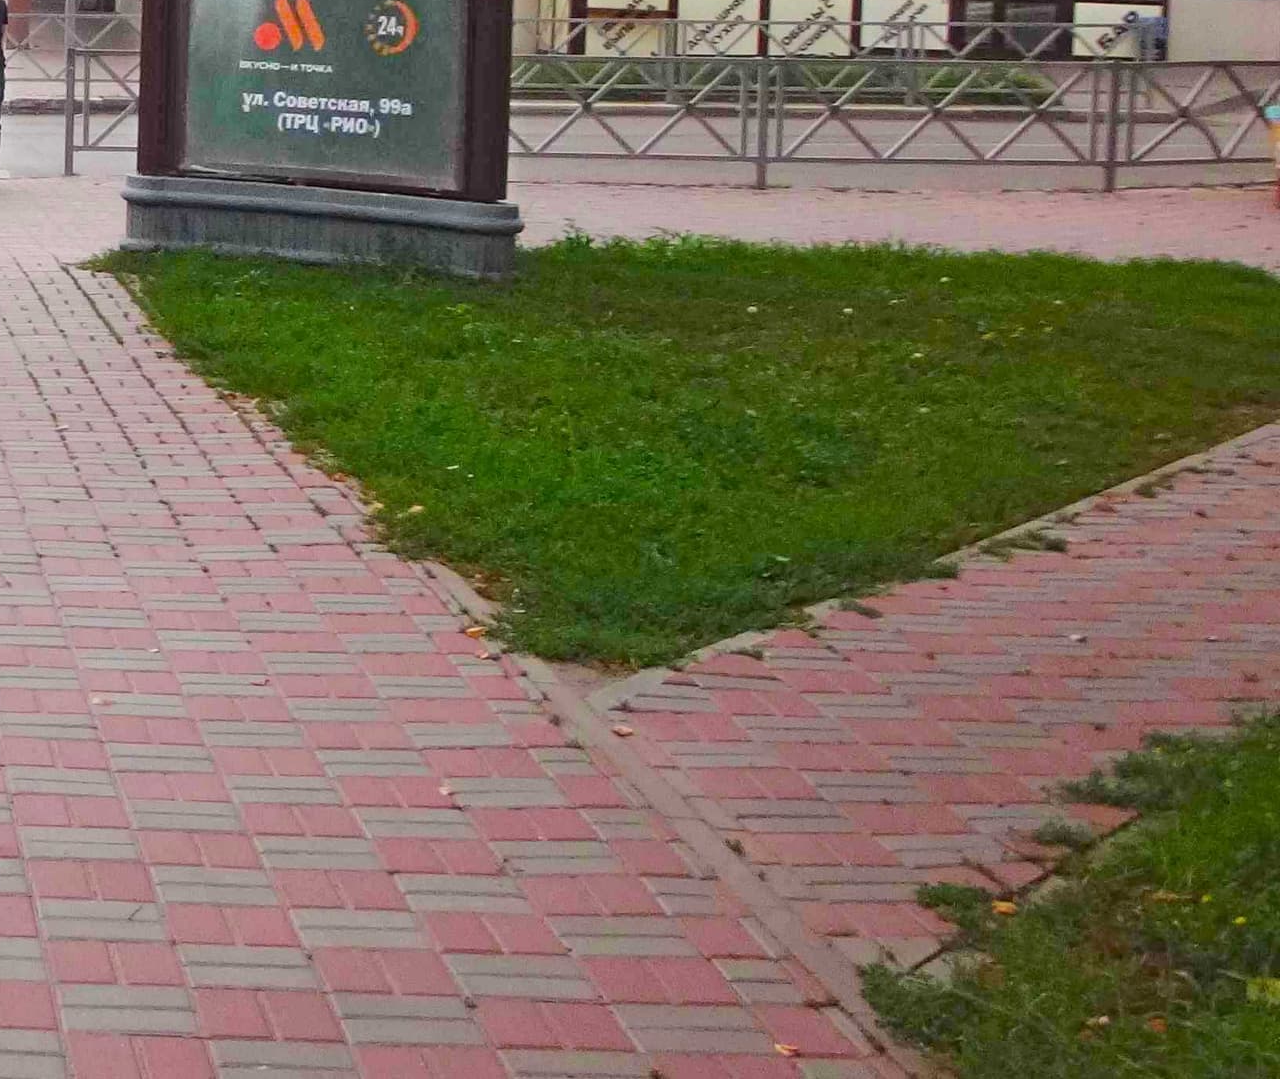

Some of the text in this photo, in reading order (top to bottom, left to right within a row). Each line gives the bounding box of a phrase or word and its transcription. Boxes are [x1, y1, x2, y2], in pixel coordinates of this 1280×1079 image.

[242, 91, 412, 116] ул. Советская, 99а
[277, 113, 319, 134] (ТРЦ
